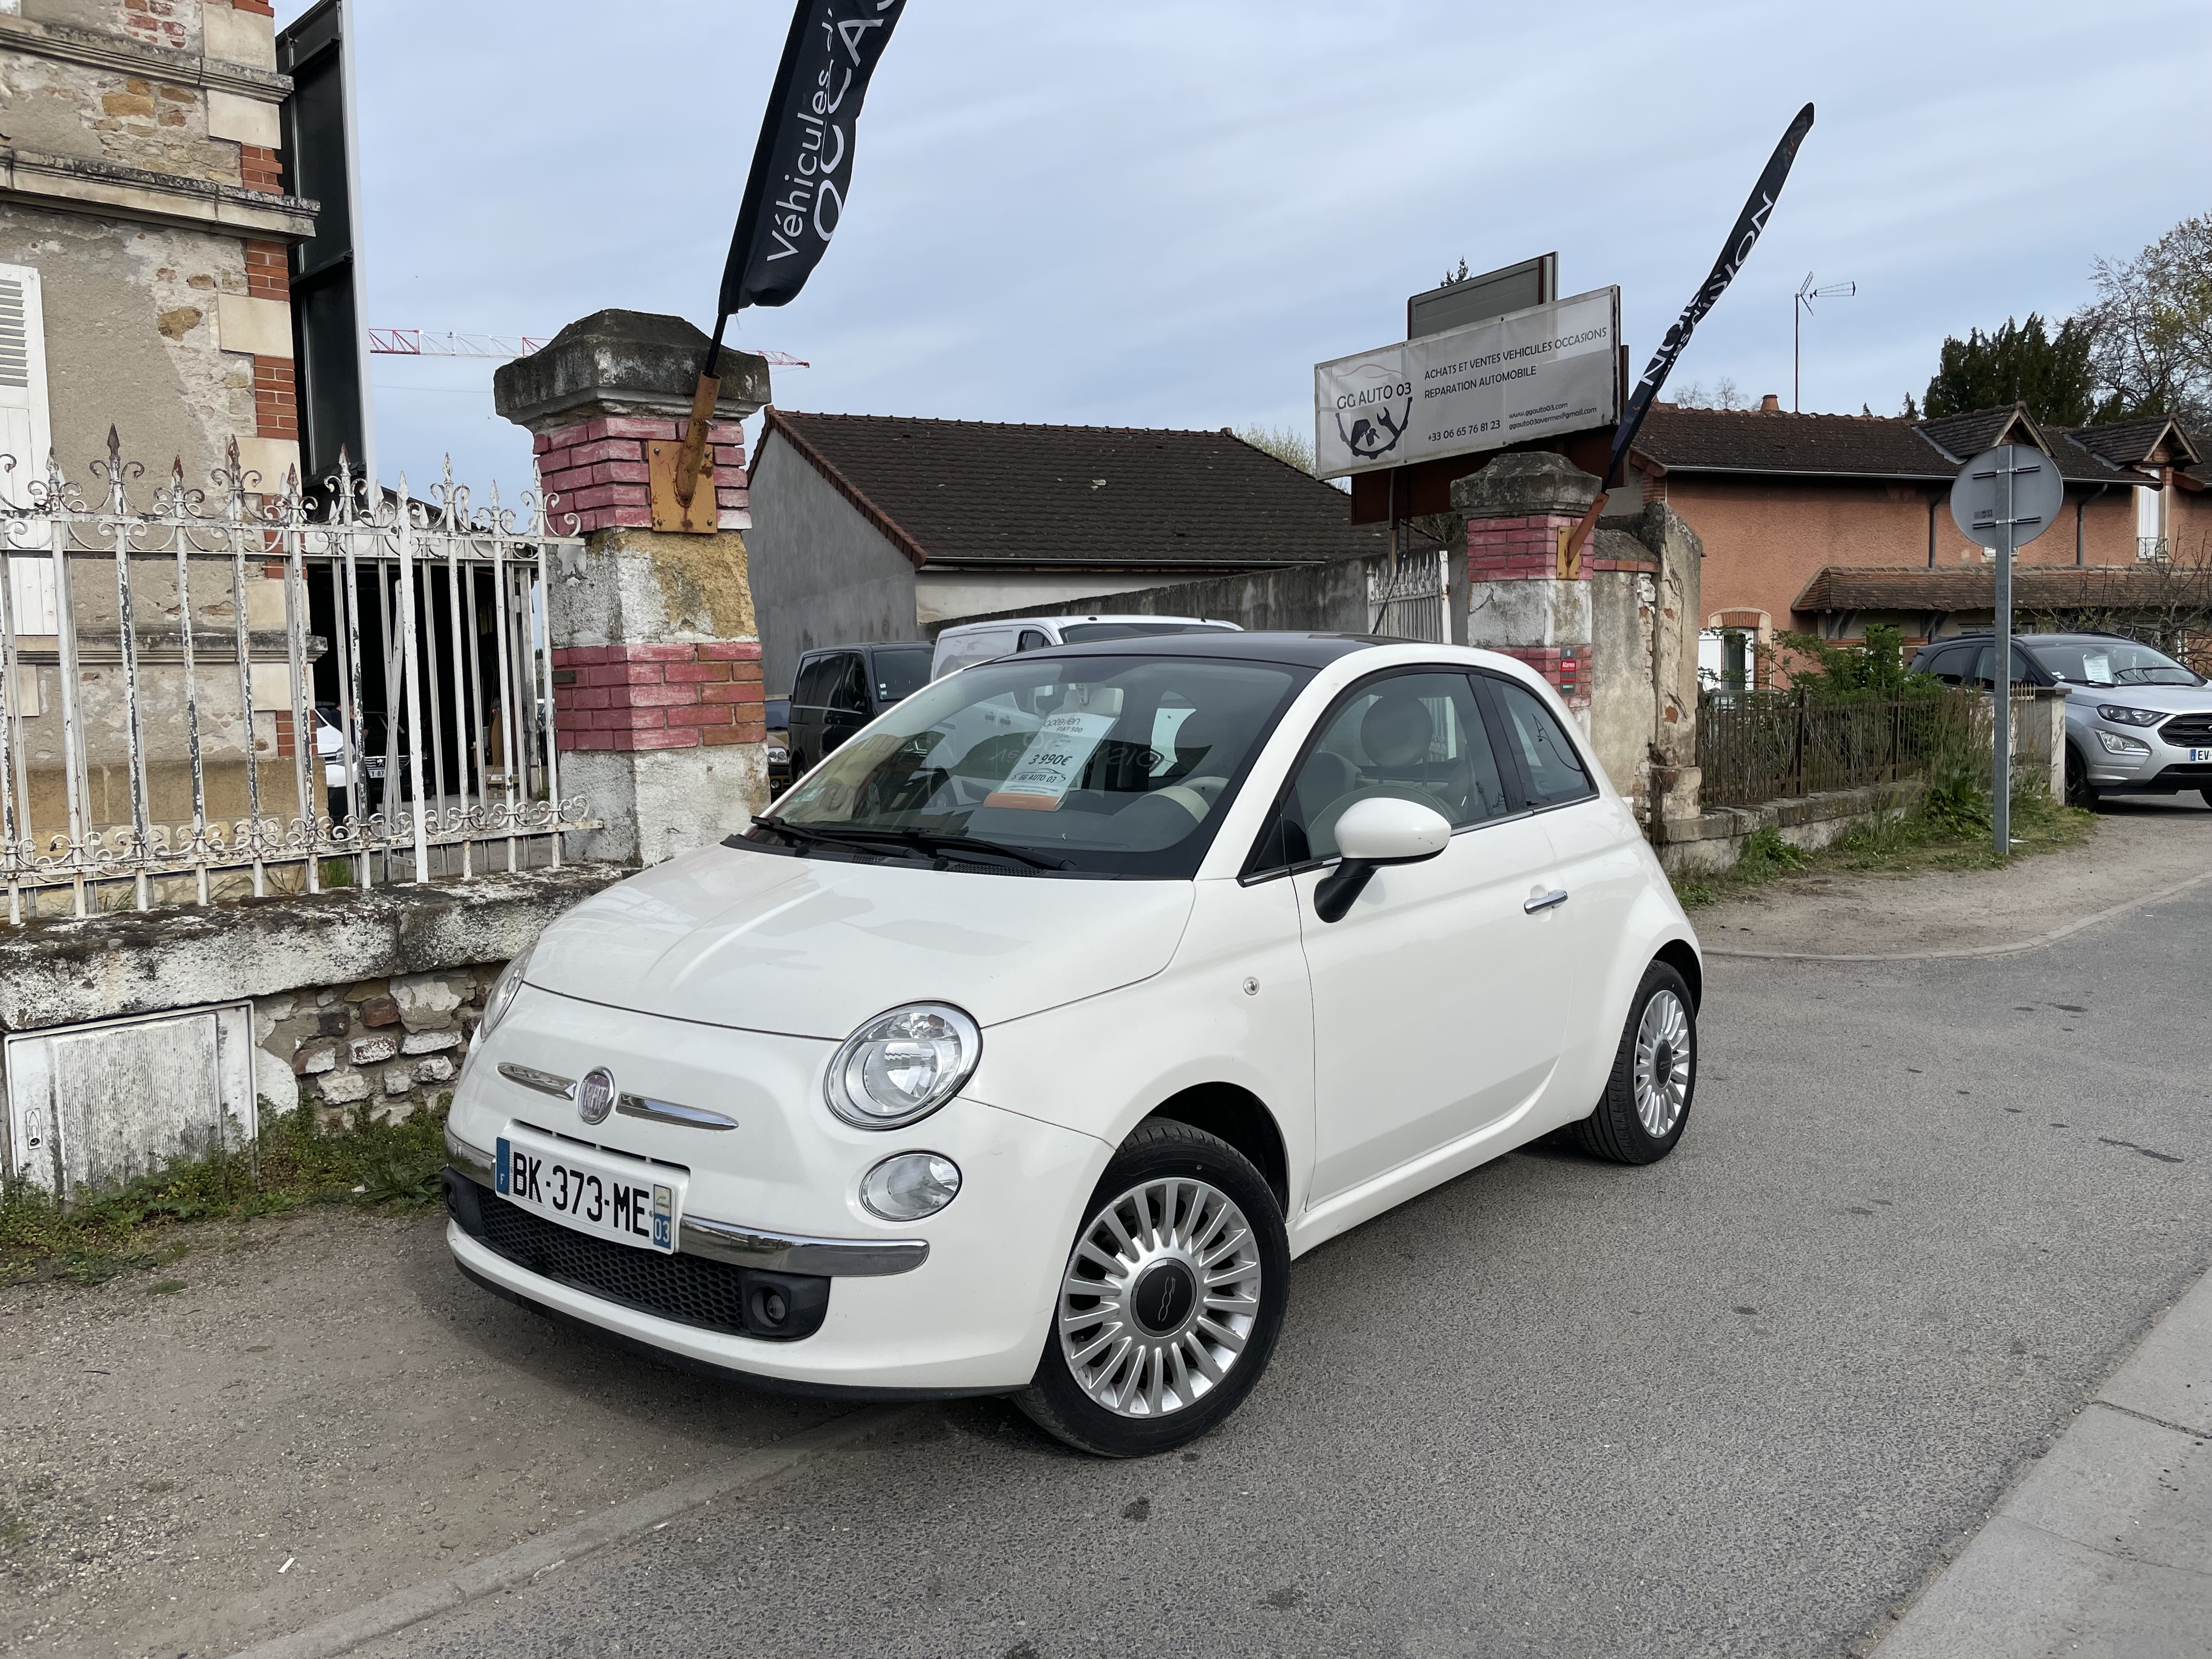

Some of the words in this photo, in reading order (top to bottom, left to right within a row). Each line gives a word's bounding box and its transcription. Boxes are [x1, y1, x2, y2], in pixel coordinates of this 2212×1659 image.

[767, 69, 830, 261] Véhicules
[1425, 365, 1457, 380] ACHATS
[1459, 362, 1468, 372] ET
[1470, 353, 1500, 369] VENTES
[1503, 341, 1552, 361] VEHICULES
[1555, 327, 1607, 349] OCCASIONS
[1336, 393, 1356, 409] GG
[1358, 385, 1393, 406] AUTO
[1396, 382, 1412, 396] 03
[1425, 379, 1477, 399] REPARATION
[1479, 366, 1537, 387] AUTOMOBILE
[1509, 403, 1568, 419] www.ggauto03.com
[1428, 433, 1441, 442] +33
[1443, 429, 1454, 439] 06
[1457, 427, 1466, 437] 65
[1469, 425, 1479, 435] 76
[1481, 422, 1488, 432] 81
[1490, 420, 1500, 430] 23
[500, 1173, 505, 1185] F
[512, 1151, 650, 1238] BK-373-ME
[654, 1218, 669, 1243] 03
